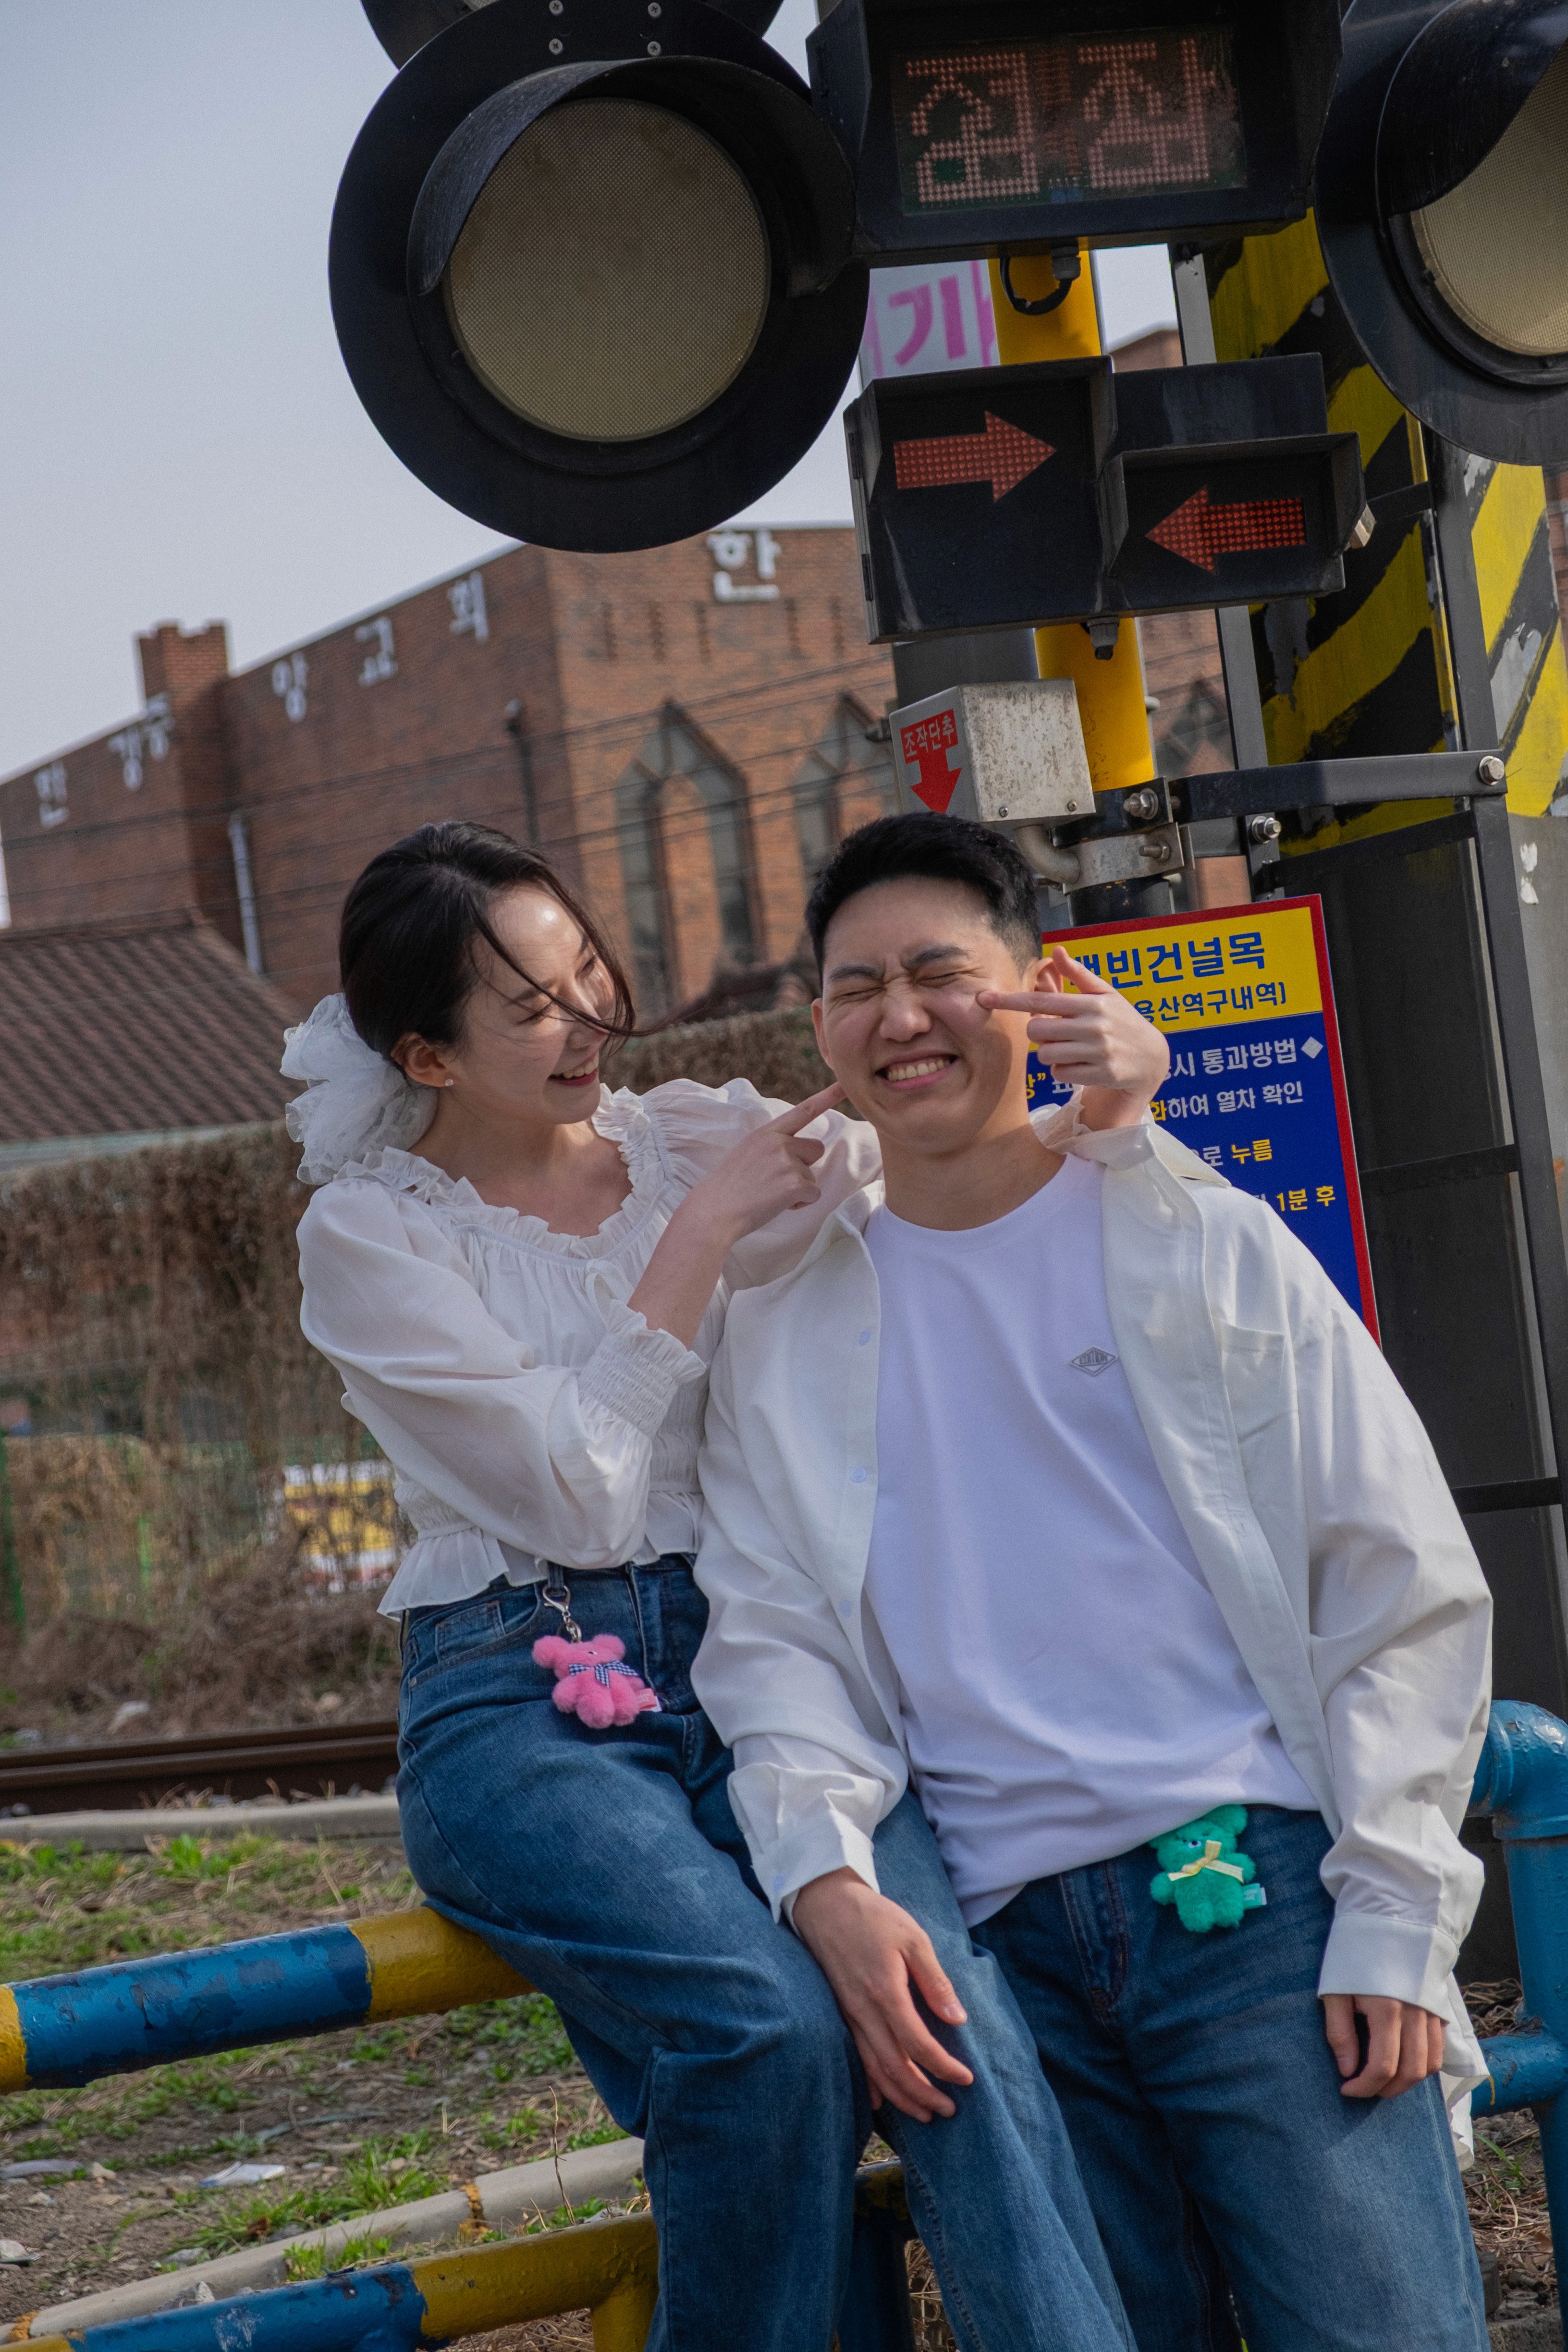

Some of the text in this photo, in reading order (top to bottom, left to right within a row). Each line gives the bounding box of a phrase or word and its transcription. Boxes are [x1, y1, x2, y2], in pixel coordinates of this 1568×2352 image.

[904, 714, 954, 758] 조작단추
[1164, 1038, 1297, 1080] 시 통과방법
[1216, 1088, 1256, 1114] 열차
[1262, 1081, 1303, 1105] 확인
[1190, 1139, 1273, 1167] 로 누름
[1276, 1186, 1336, 1212] 1분 후
